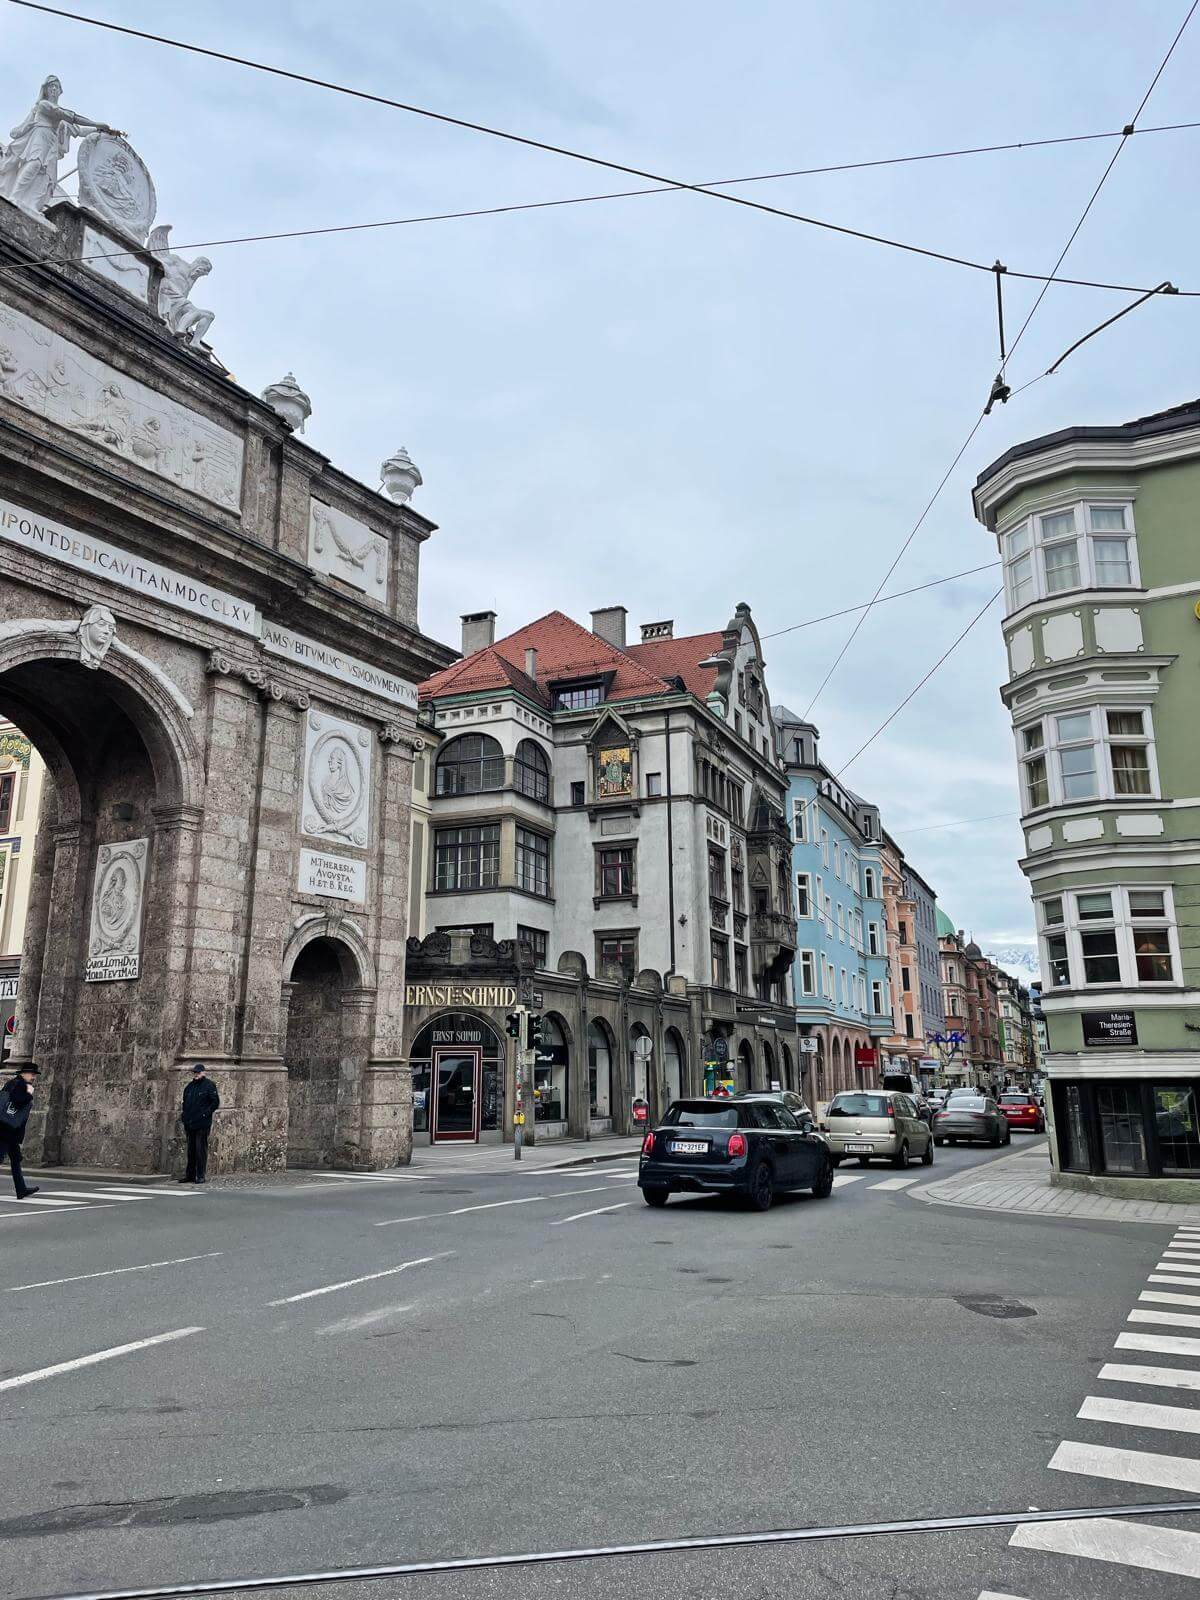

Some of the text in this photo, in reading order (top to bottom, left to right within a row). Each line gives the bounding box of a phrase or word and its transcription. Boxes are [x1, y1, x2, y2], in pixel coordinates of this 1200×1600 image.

[406, 986, 454, 1006] ERNST
[462, 986, 516, 1007] SCHMID
[1110, 1013, 1133, 1021] Maria-
[1099, 1021, 1133, 1029] Theresien-
[1110, 1028, 1132, 1036] Straße
[433, 1031, 481, 1042] ERNST SCHMID
